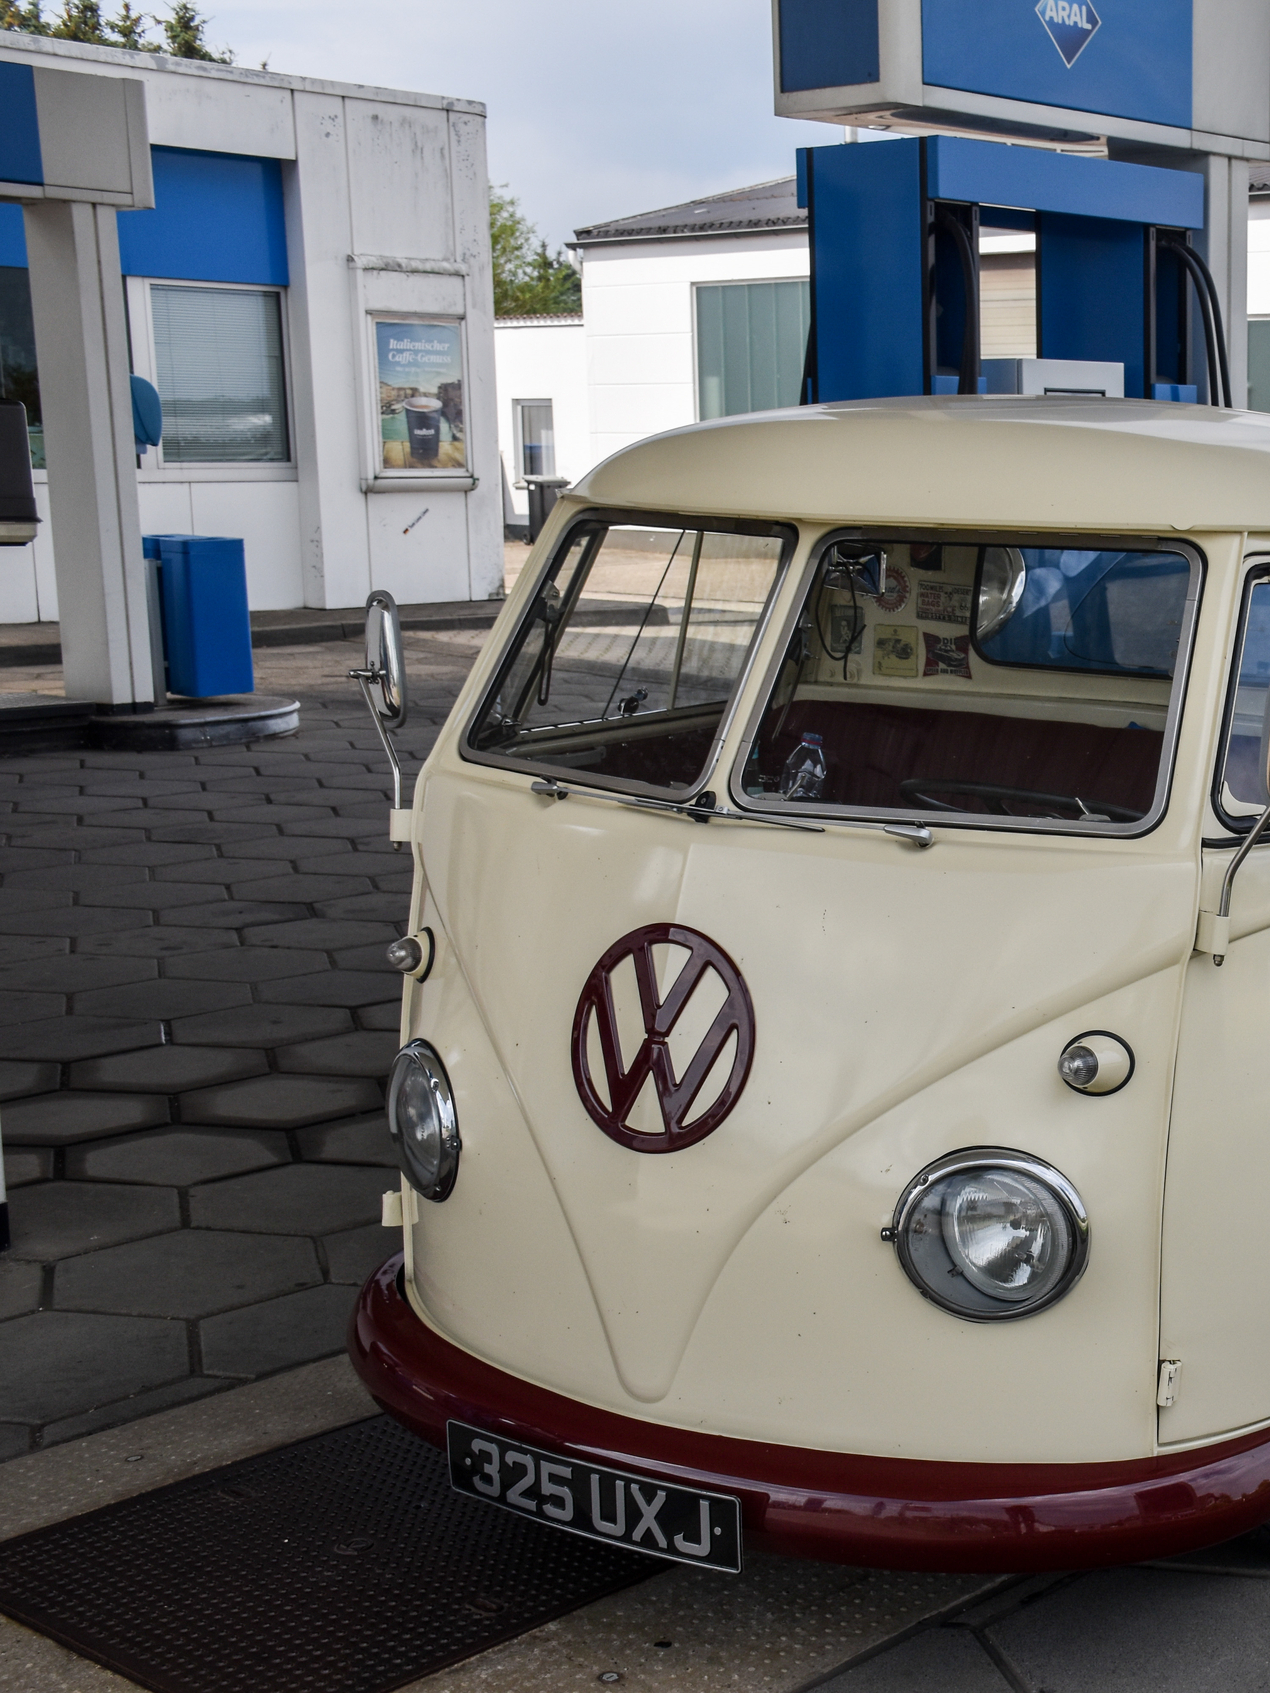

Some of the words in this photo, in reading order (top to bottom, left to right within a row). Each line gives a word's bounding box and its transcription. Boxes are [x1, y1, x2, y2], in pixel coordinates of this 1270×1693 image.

[1045, 0, 1092, 30] ARAL
[389, 339, 450, 351] Italienischer
[471, 1438, 574, 1523] 325
[590, 1473, 711, 1557] UXJ
